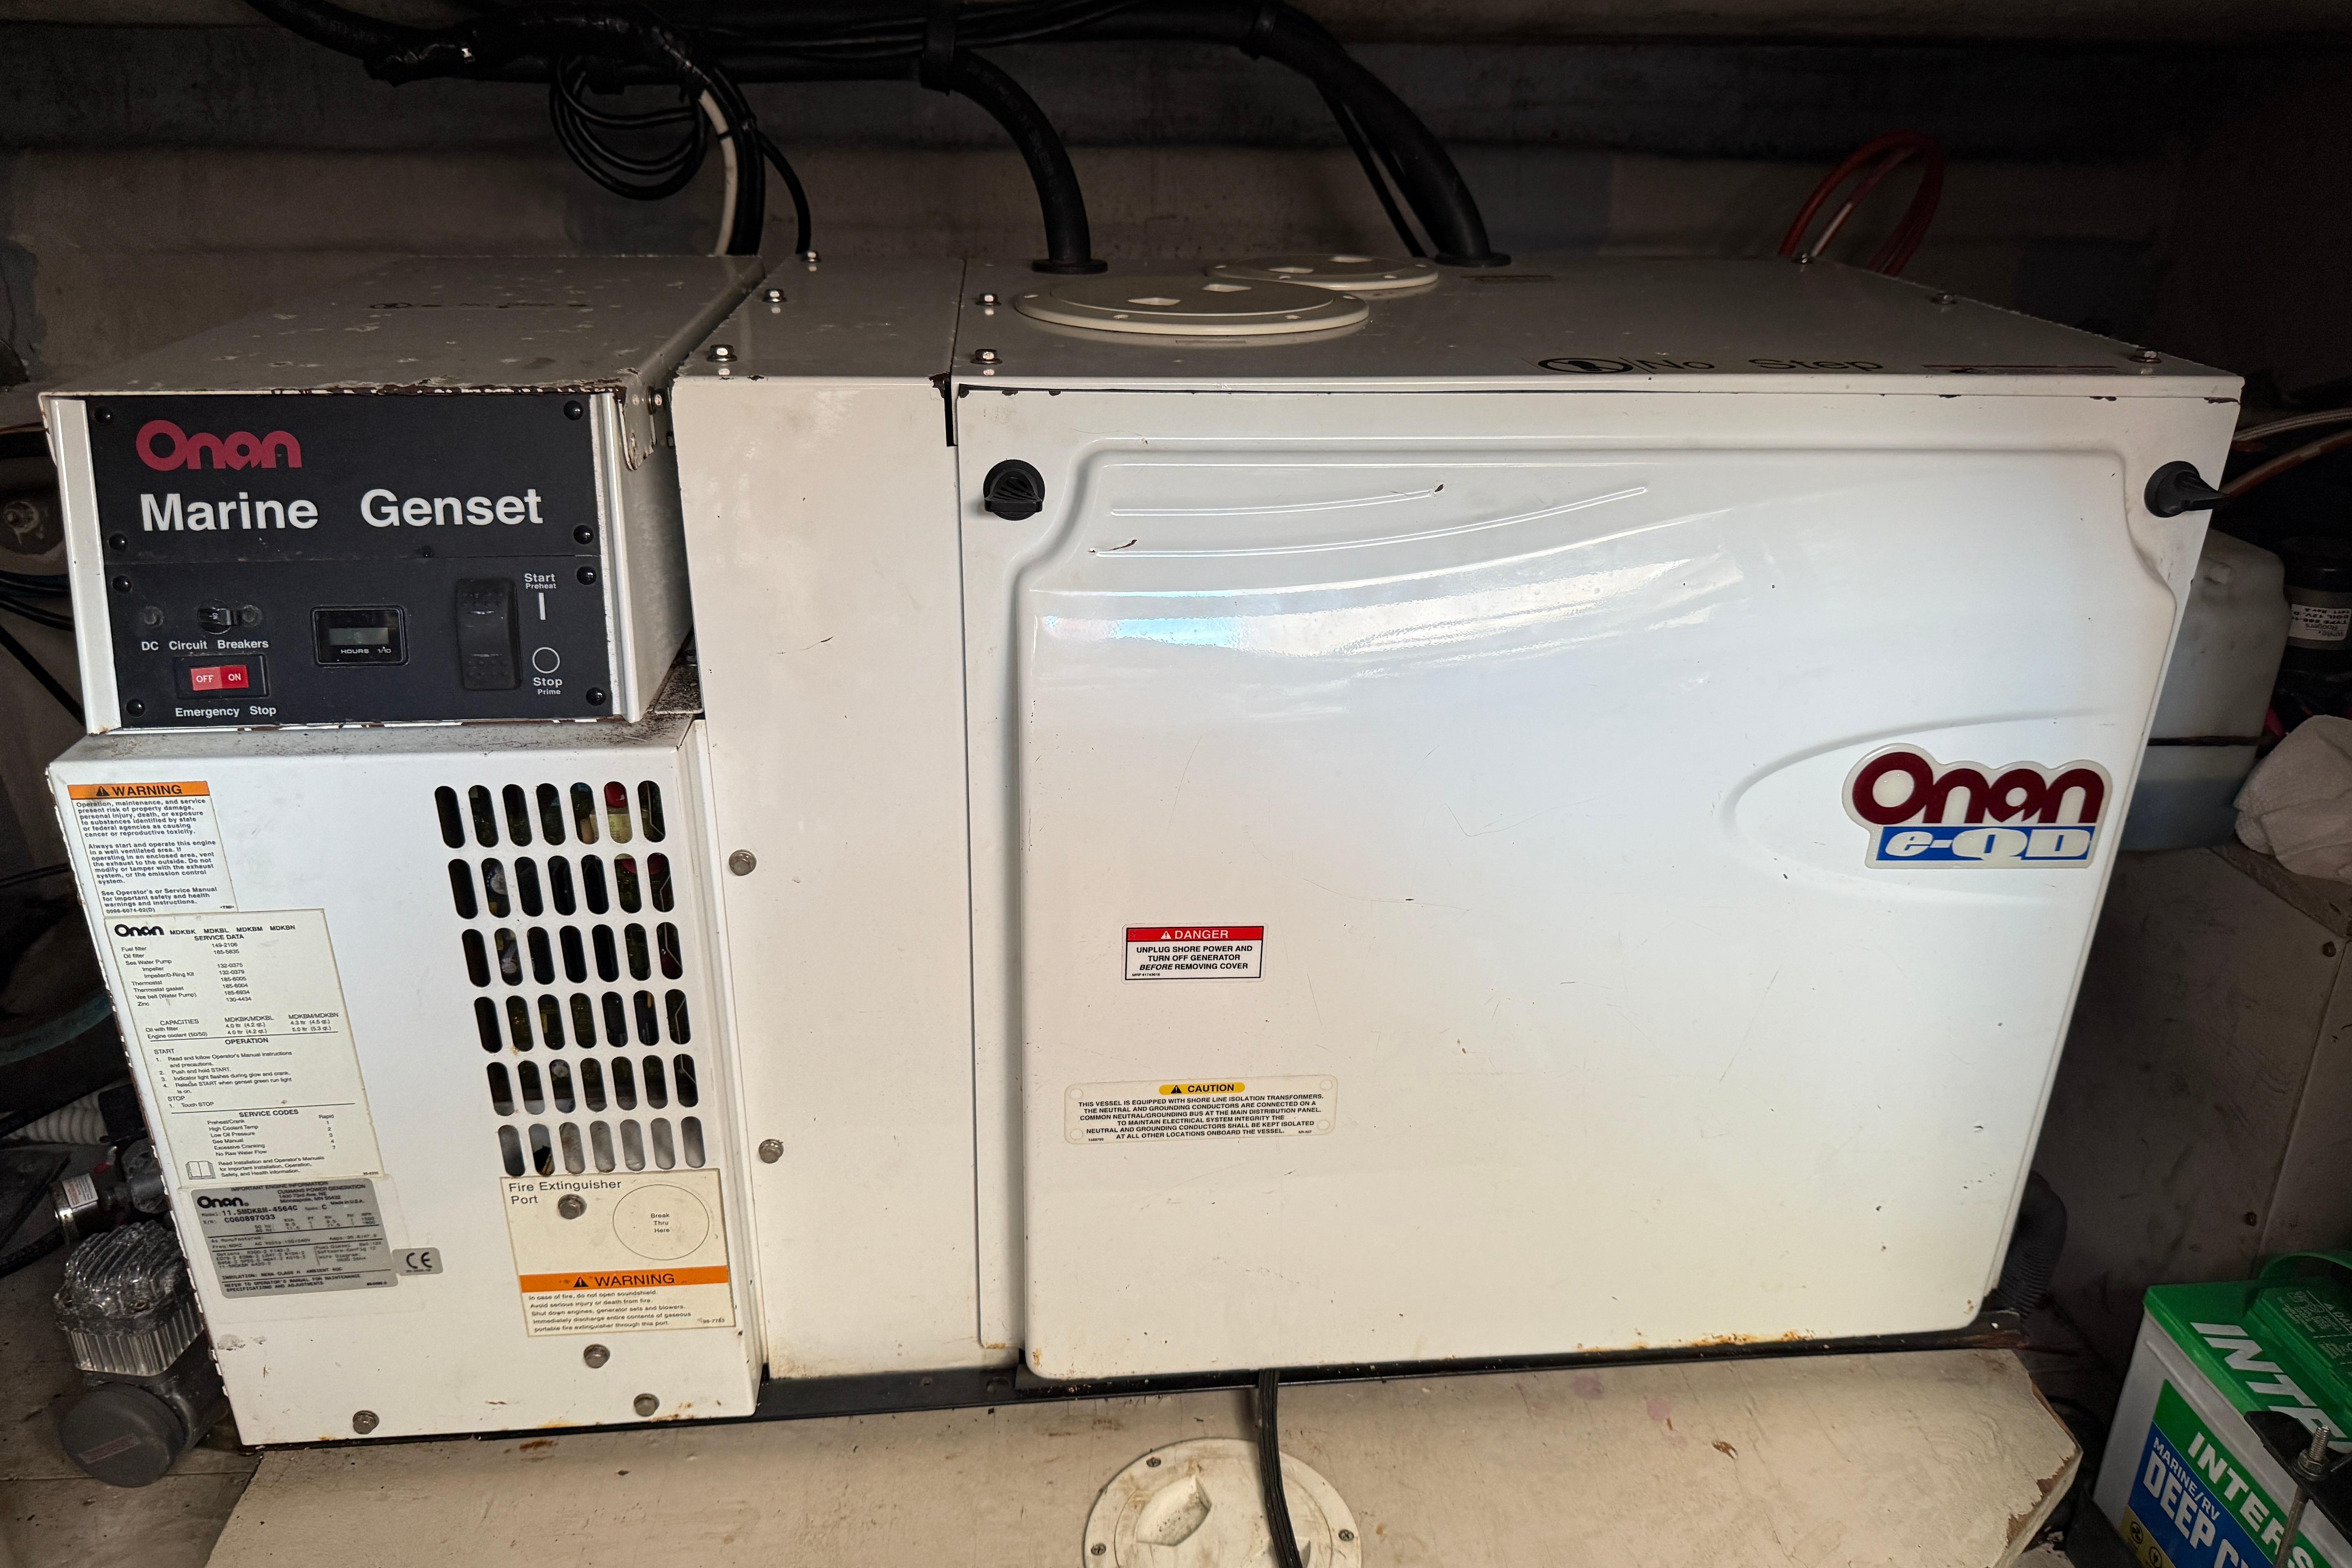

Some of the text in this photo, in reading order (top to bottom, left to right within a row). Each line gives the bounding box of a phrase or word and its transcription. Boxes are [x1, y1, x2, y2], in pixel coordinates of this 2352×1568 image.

[1636, 359, 1883, 371] No Step
[136, 420, 302, 471] Onan
[140, 488, 543, 531] Marine Genset
[524, 573, 555, 582] Start
[141, 639, 269, 651] DC Circuit Breakers
[228, 673, 241, 681] ON
[533, 677, 562, 688] Stop
[175, 705, 276, 718] Emergency Stop
[111, 784, 182, 796] WARNING
[1853, 751, 2105, 825] Onan
[114, 924, 165, 937] Onan
[1174, 929, 1228, 939] DANGER
[1188, 1084, 1234, 1092] CAUTION
[509, 1179, 621, 1192] Fire Extinguisher
[197, 1195, 244, 1209] Onan
[511, 1195, 538, 1204] Port
[594, 1273, 675, 1287] WARNING
[2154, 1437, 2220, 1521] MARINE/RV
[2143, 1450, 2216, 1549] DEEP
